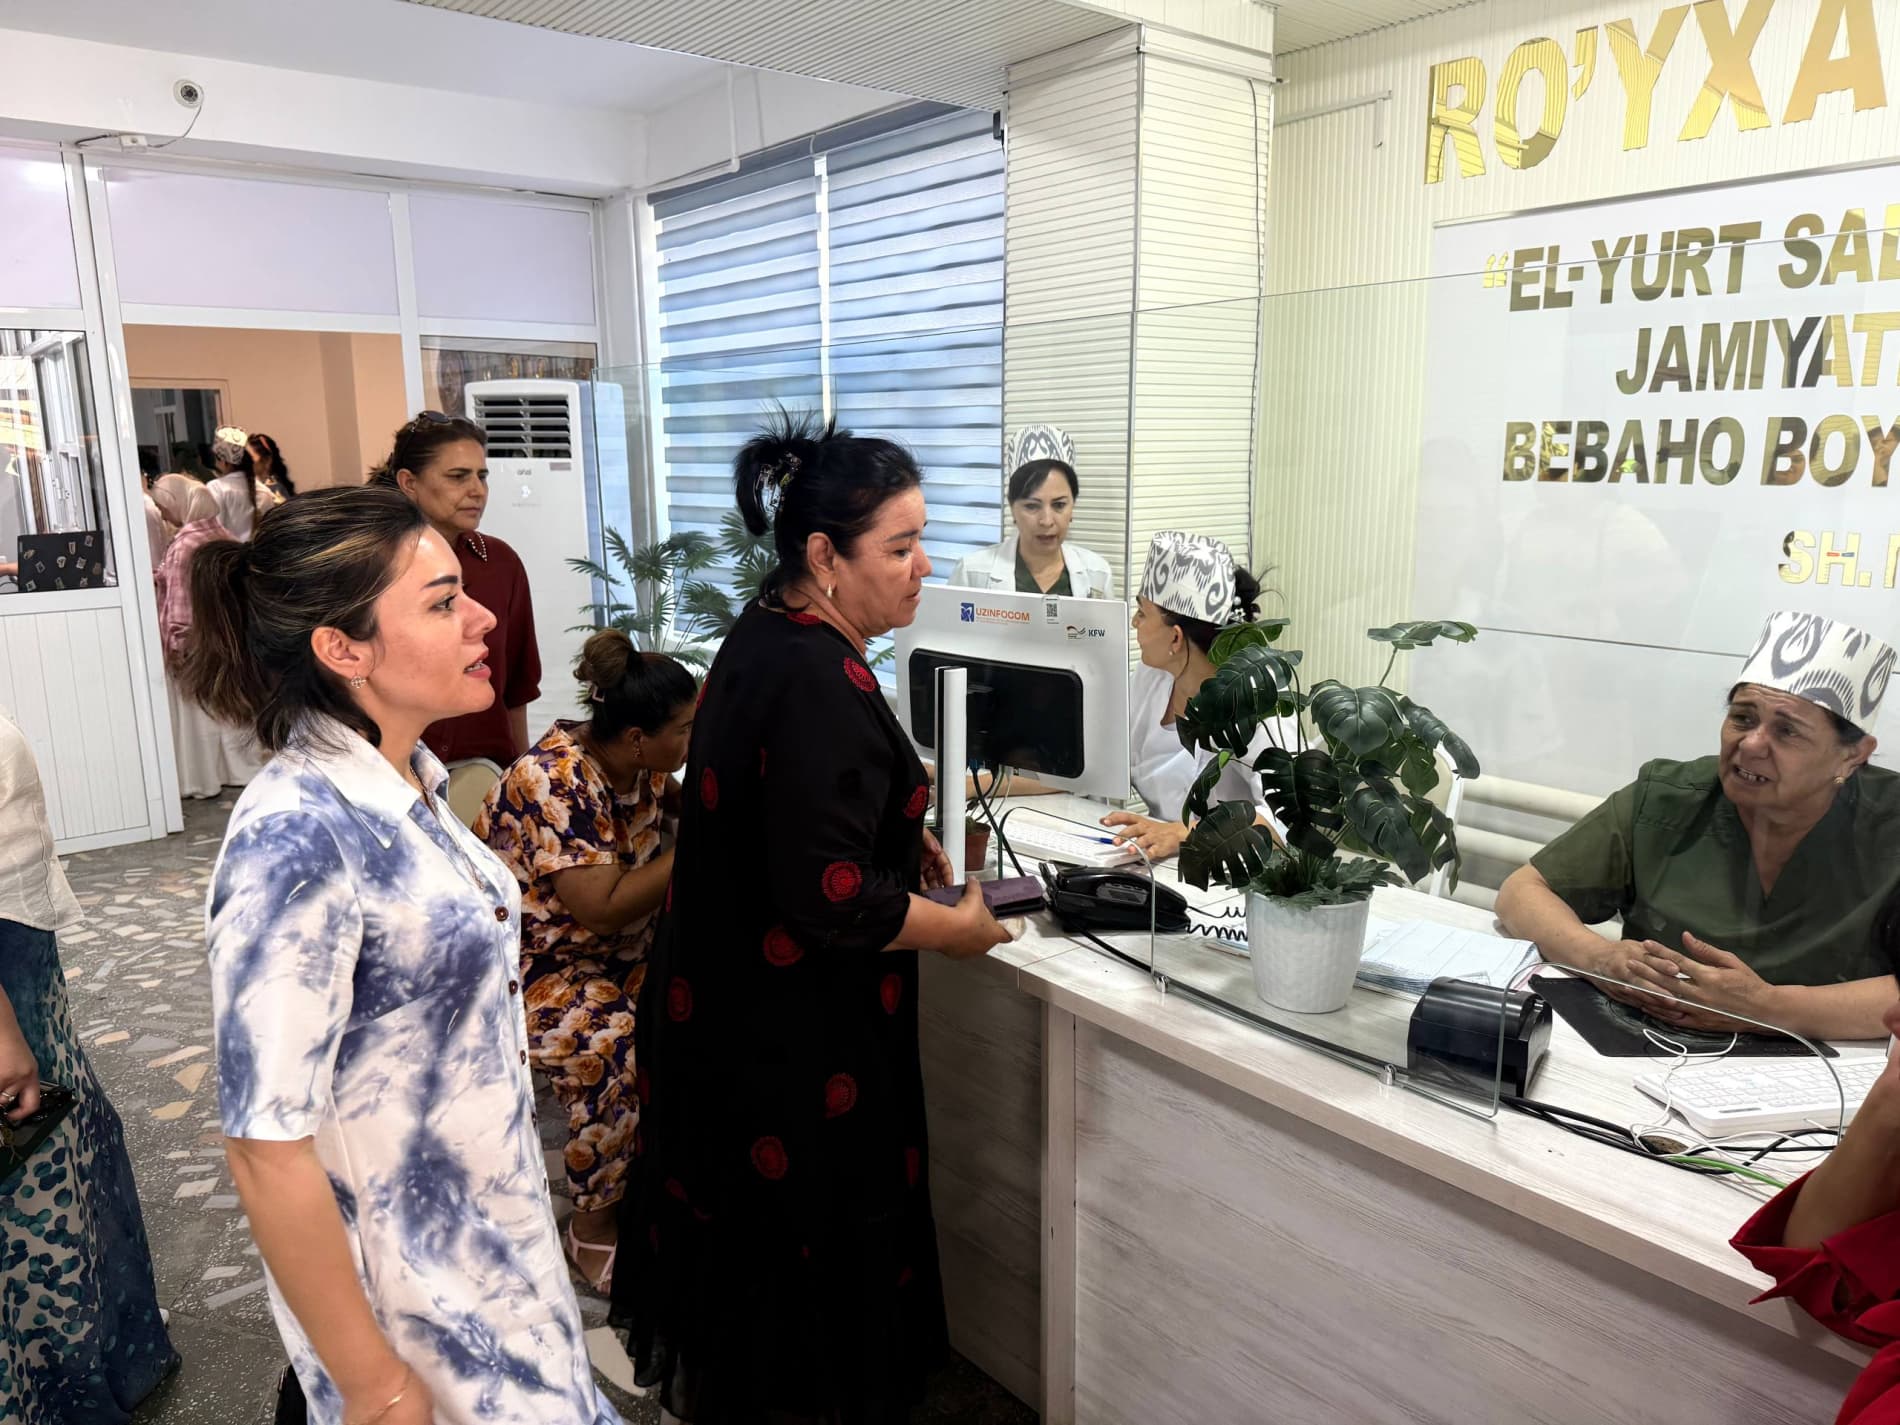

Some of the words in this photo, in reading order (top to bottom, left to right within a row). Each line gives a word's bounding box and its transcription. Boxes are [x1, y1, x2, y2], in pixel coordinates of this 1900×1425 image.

[1616, 311, 1900, 395] JAMIYAT
[1502, 416, 1746, 486] BEBAHO
[976, 607, 1030, 621] UZINFOCOM
